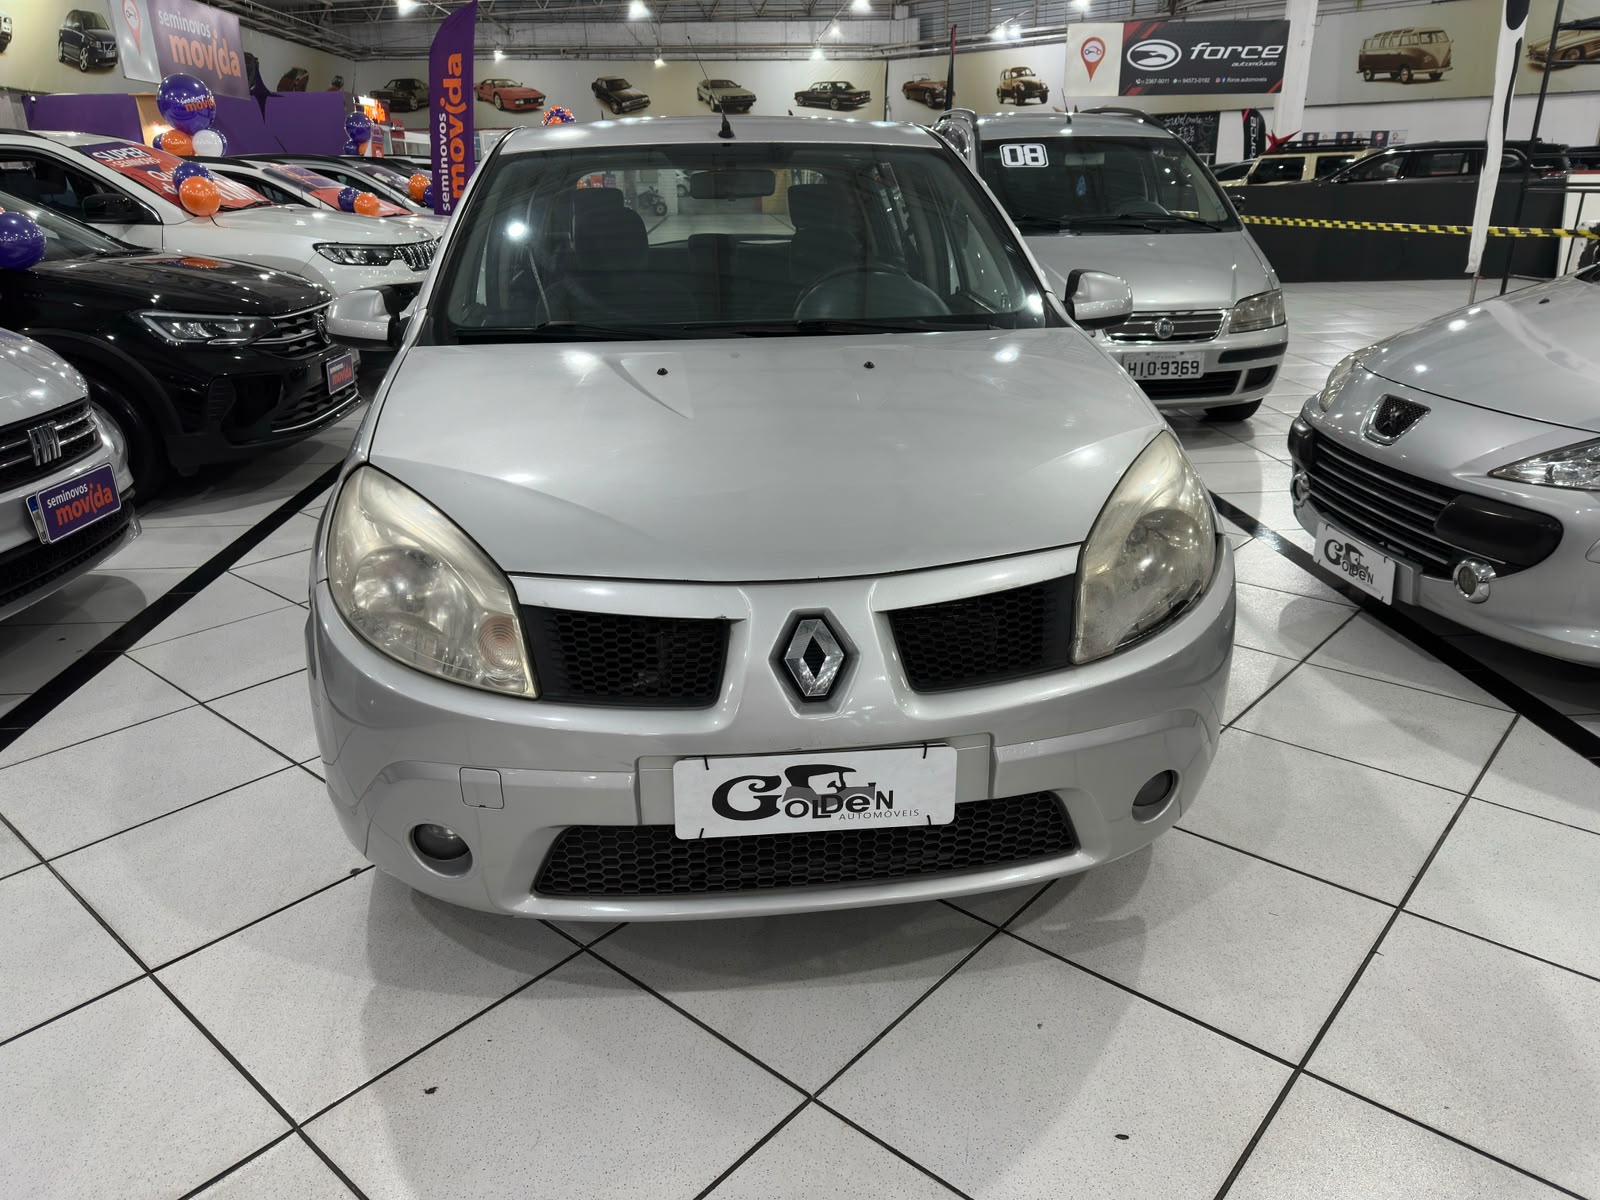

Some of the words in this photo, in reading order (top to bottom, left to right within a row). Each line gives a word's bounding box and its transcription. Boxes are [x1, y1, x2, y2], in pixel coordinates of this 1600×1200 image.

[158, 10, 211, 38] seminovos
[169, 28, 242, 80] movida
[1190, 42, 1284, 60] force
[440, 53, 467, 199] movida
[92, 147, 152, 162] SUPER
[438, 113, 450, 211] seminovos
[1002, 145, 1046, 166] 08
[47, 483, 88, 508] seminovos
[55, 483, 113, 526] movida
[838, 808, 921, 821] AUTOMÓVEIS
